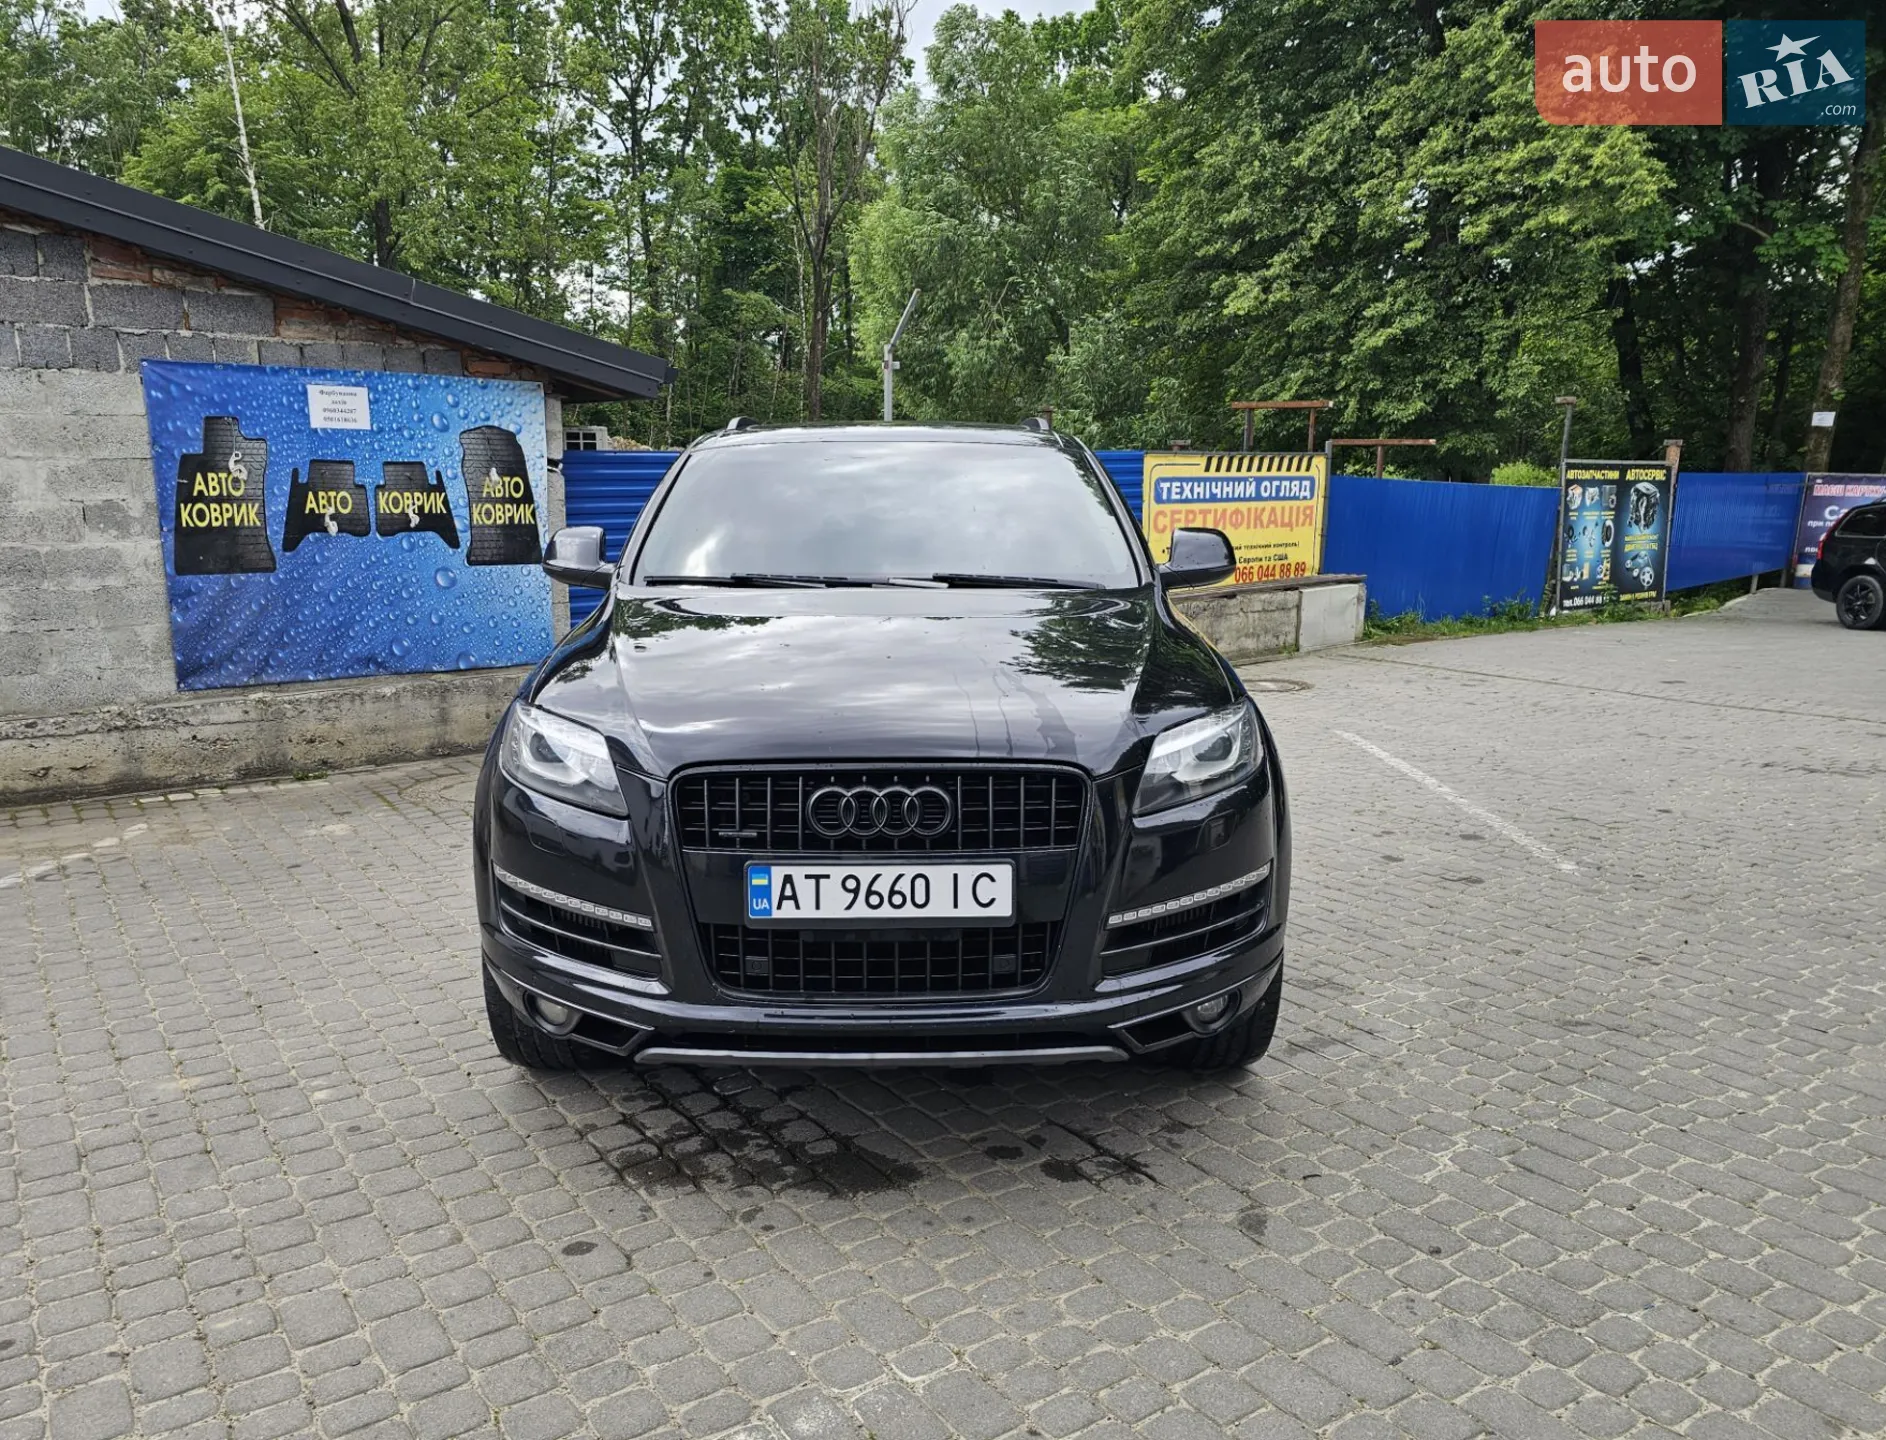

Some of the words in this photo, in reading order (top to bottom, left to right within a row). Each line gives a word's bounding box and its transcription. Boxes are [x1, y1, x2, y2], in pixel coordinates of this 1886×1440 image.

[192, 472, 245, 498] АВТО
[1625, 468, 1667, 481] АВТОСЕРВІС
[482, 475, 524, 499] АВТО
[1160, 478, 1255, 500] ТЕХНІЧНИЙ
[1260, 480, 1311, 499] ОГЛЯД
[305, 490, 352, 514] АВТО
[378, 491, 447, 515] КОВРИК
[472, 503, 535, 525] КОВРИК
[180, 502, 262, 528] КОВРИК
[1153, 504, 1314, 534] СЕРТИФІКАЦІЯ
[1273, 553, 1289, 561] США
[1234, 566, 1254, 584] 066
[1257, 564, 1277, 582] 044
[1279, 562, 1291, 579] 88
[1294, 561, 1307, 577] 89
[776, 873, 831, 911] AT
[841, 872, 931, 911] 9660
[952, 872, 997, 910] IC
[752, 898, 770, 910] UA
